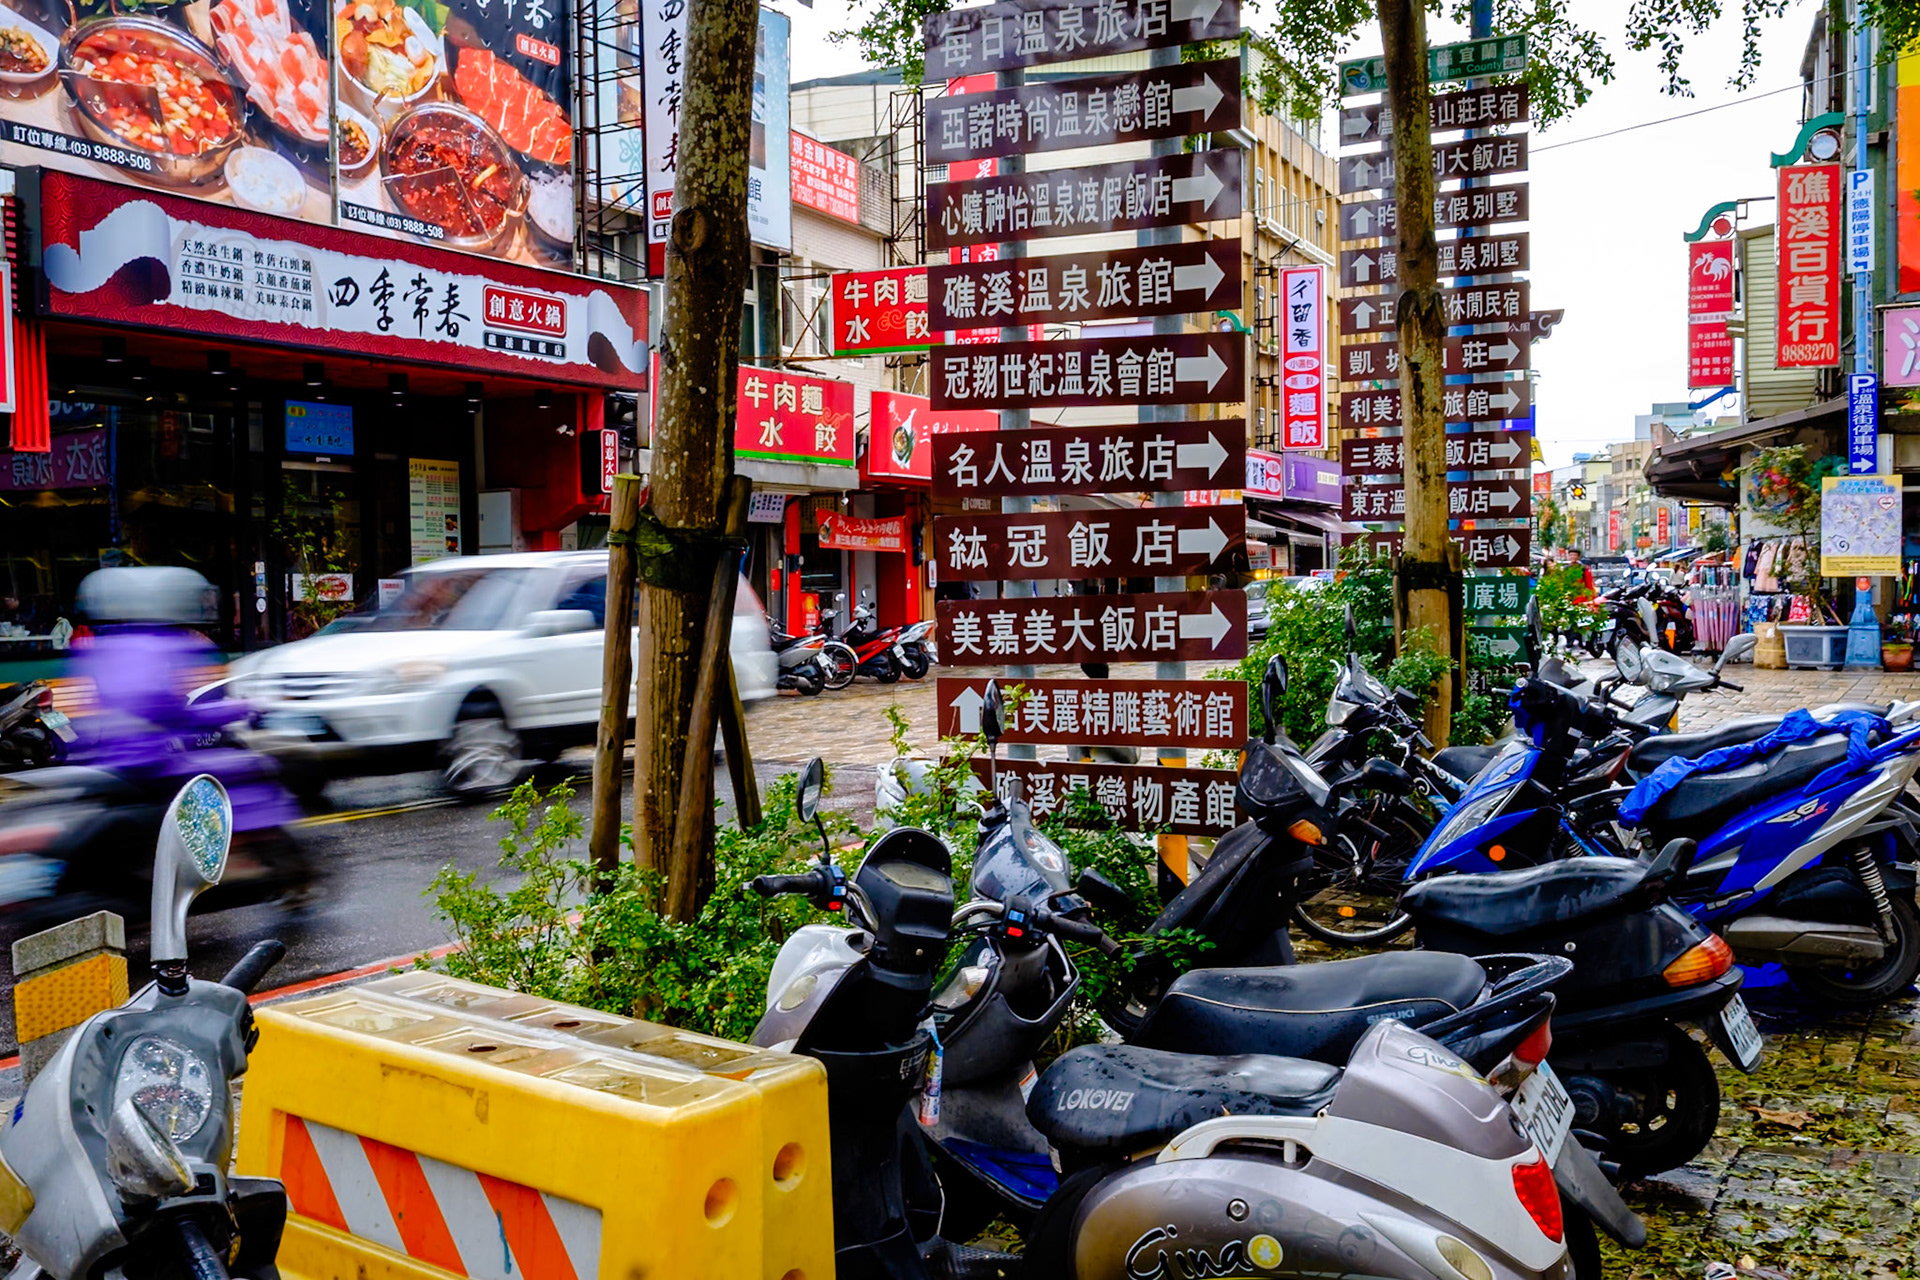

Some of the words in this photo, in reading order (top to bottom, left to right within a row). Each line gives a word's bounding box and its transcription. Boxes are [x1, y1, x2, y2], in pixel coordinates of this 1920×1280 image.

[940, 0, 1167, 68] 每日溫泉旅店
[1466, 60, 1503, 75] County
[940, 80, 1171, 150] 亞諾時尚溫泉戀館
[1378, 92, 1519, 136] 盧山莊民宿
[12, 125, 68, 150] 訂位專線
[70, 140, 92, 159] (03)
[94, 143, 151, 171] 9888-508
[1379, 141, 1519, 183] 山利大飯店
[1853, 172, 1869, 190] P
[940, 169, 1171, 236] 心曠神怡溫泉渡假飯店
[1377, 191, 1518, 228] 昀假別墅
[386, 213, 402, 231] (03)
[402, 217, 444, 240] 9888-508
[1852, 198, 1870, 258] 德陽停車場
[181, 240, 243, 261] 天然養生鍋
[254, 251, 312, 274] 懷舊石頭鍋
[181, 259, 243, 282] 香濃牛奶鍋
[1378, 240, 1519, 280] 懷溫泉別墅
[1786, 171, 1830, 343] 礁溪百貨行
[256, 291, 312, 312] 美味素食鍋
[328, 265, 471, 338] 四季常春
[844, 273, 928, 309] 牛肉麵
[942, 257, 1172, 319] 礁溪溫泉旅館
[489, 293, 561, 329] 創意火鍋
[845, 310, 930, 345] 水餃
[1782, 342, 1835, 362] 9883270
[944, 347, 1175, 400] 冠翔世紀溫泉會館
[1852, 375, 1875, 394] P
[744, 376, 823, 416] 牛肉麵
[1350, 389, 1489, 423] 利美旅館
[759, 417, 836, 453] 水餃
[1289, 393, 1318, 445] 麵飯
[1853, 394, 1875, 456] 溫泉街停車場
[948, 434, 1176, 488] 名人溫泉旅店
[1351, 438, 1490, 470] 三泰飯店
[1350, 486, 1489, 517] 東京溫飯店
[949, 519, 1176, 571] 紘冠飯店
[951, 604, 1178, 656] 美嘉美大飯店
[1367, 1008, 1415, 1025] SUZUKI
[1057, 1090, 1134, 1111] LOKOVEI
[1126, 1223, 1254, 1280] Gina
